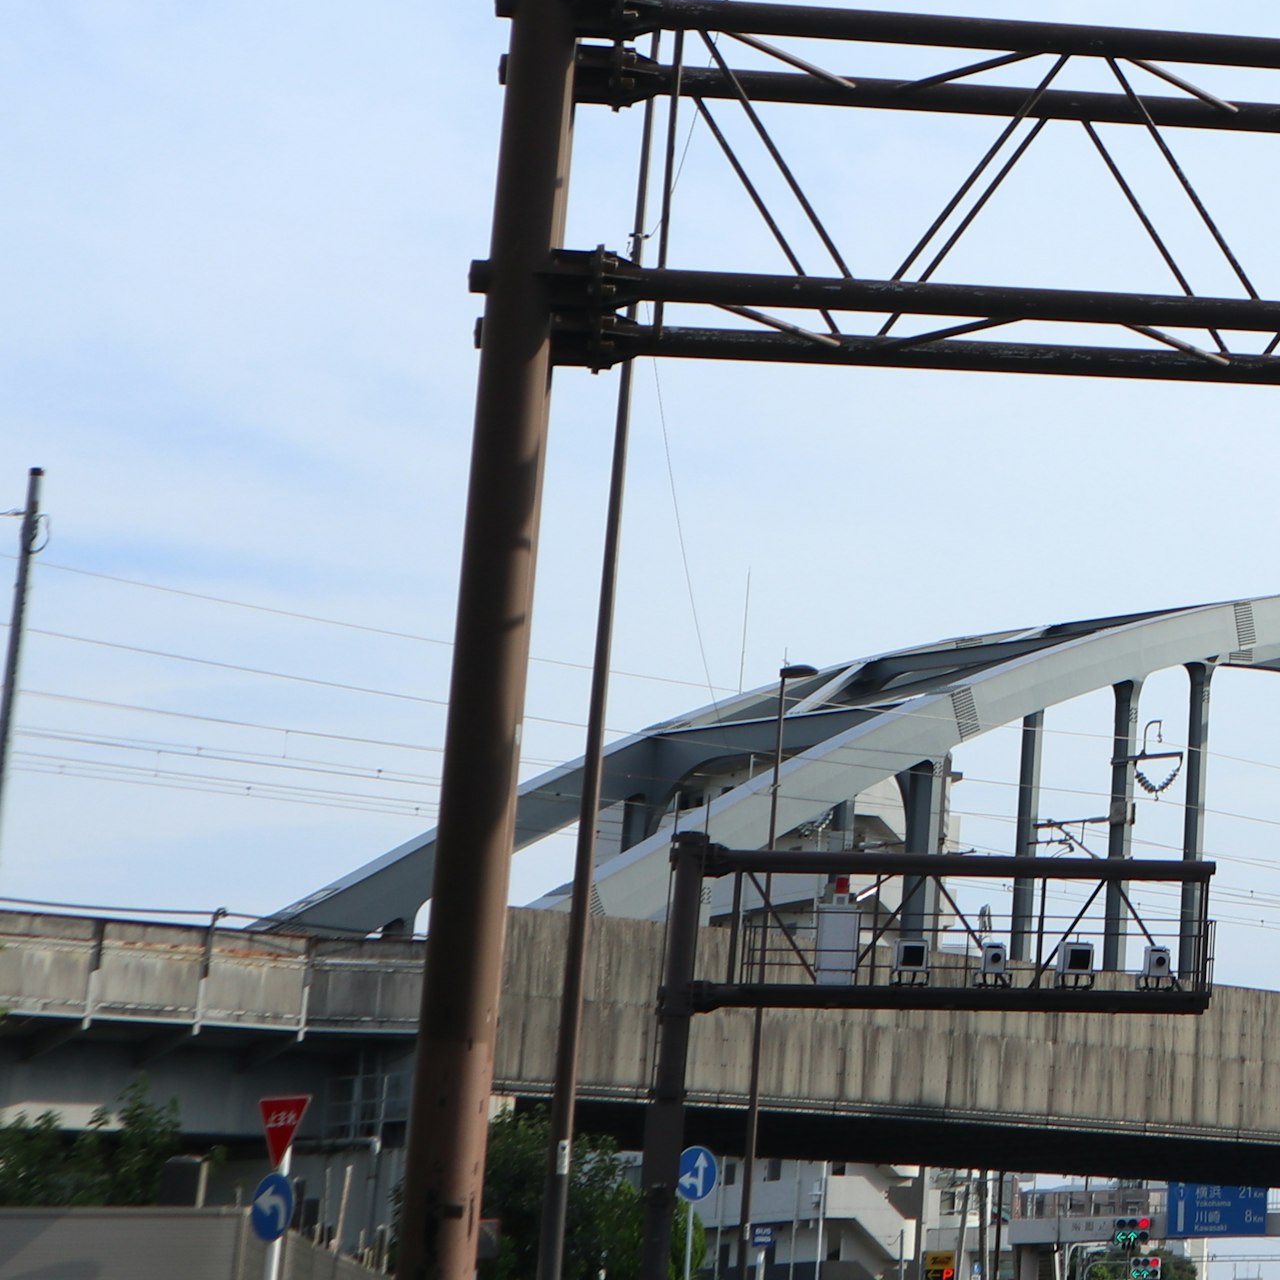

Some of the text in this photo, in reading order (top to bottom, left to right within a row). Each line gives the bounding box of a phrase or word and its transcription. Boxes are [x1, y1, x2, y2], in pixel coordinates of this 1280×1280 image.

[266, 1111, 298, 1128] とまれ
[1195, 1186, 1221, 1199] 横浜
[1196, 1200, 1231, 1208] Yokohama
[1195, 1212, 1221, 1224] 川崎
